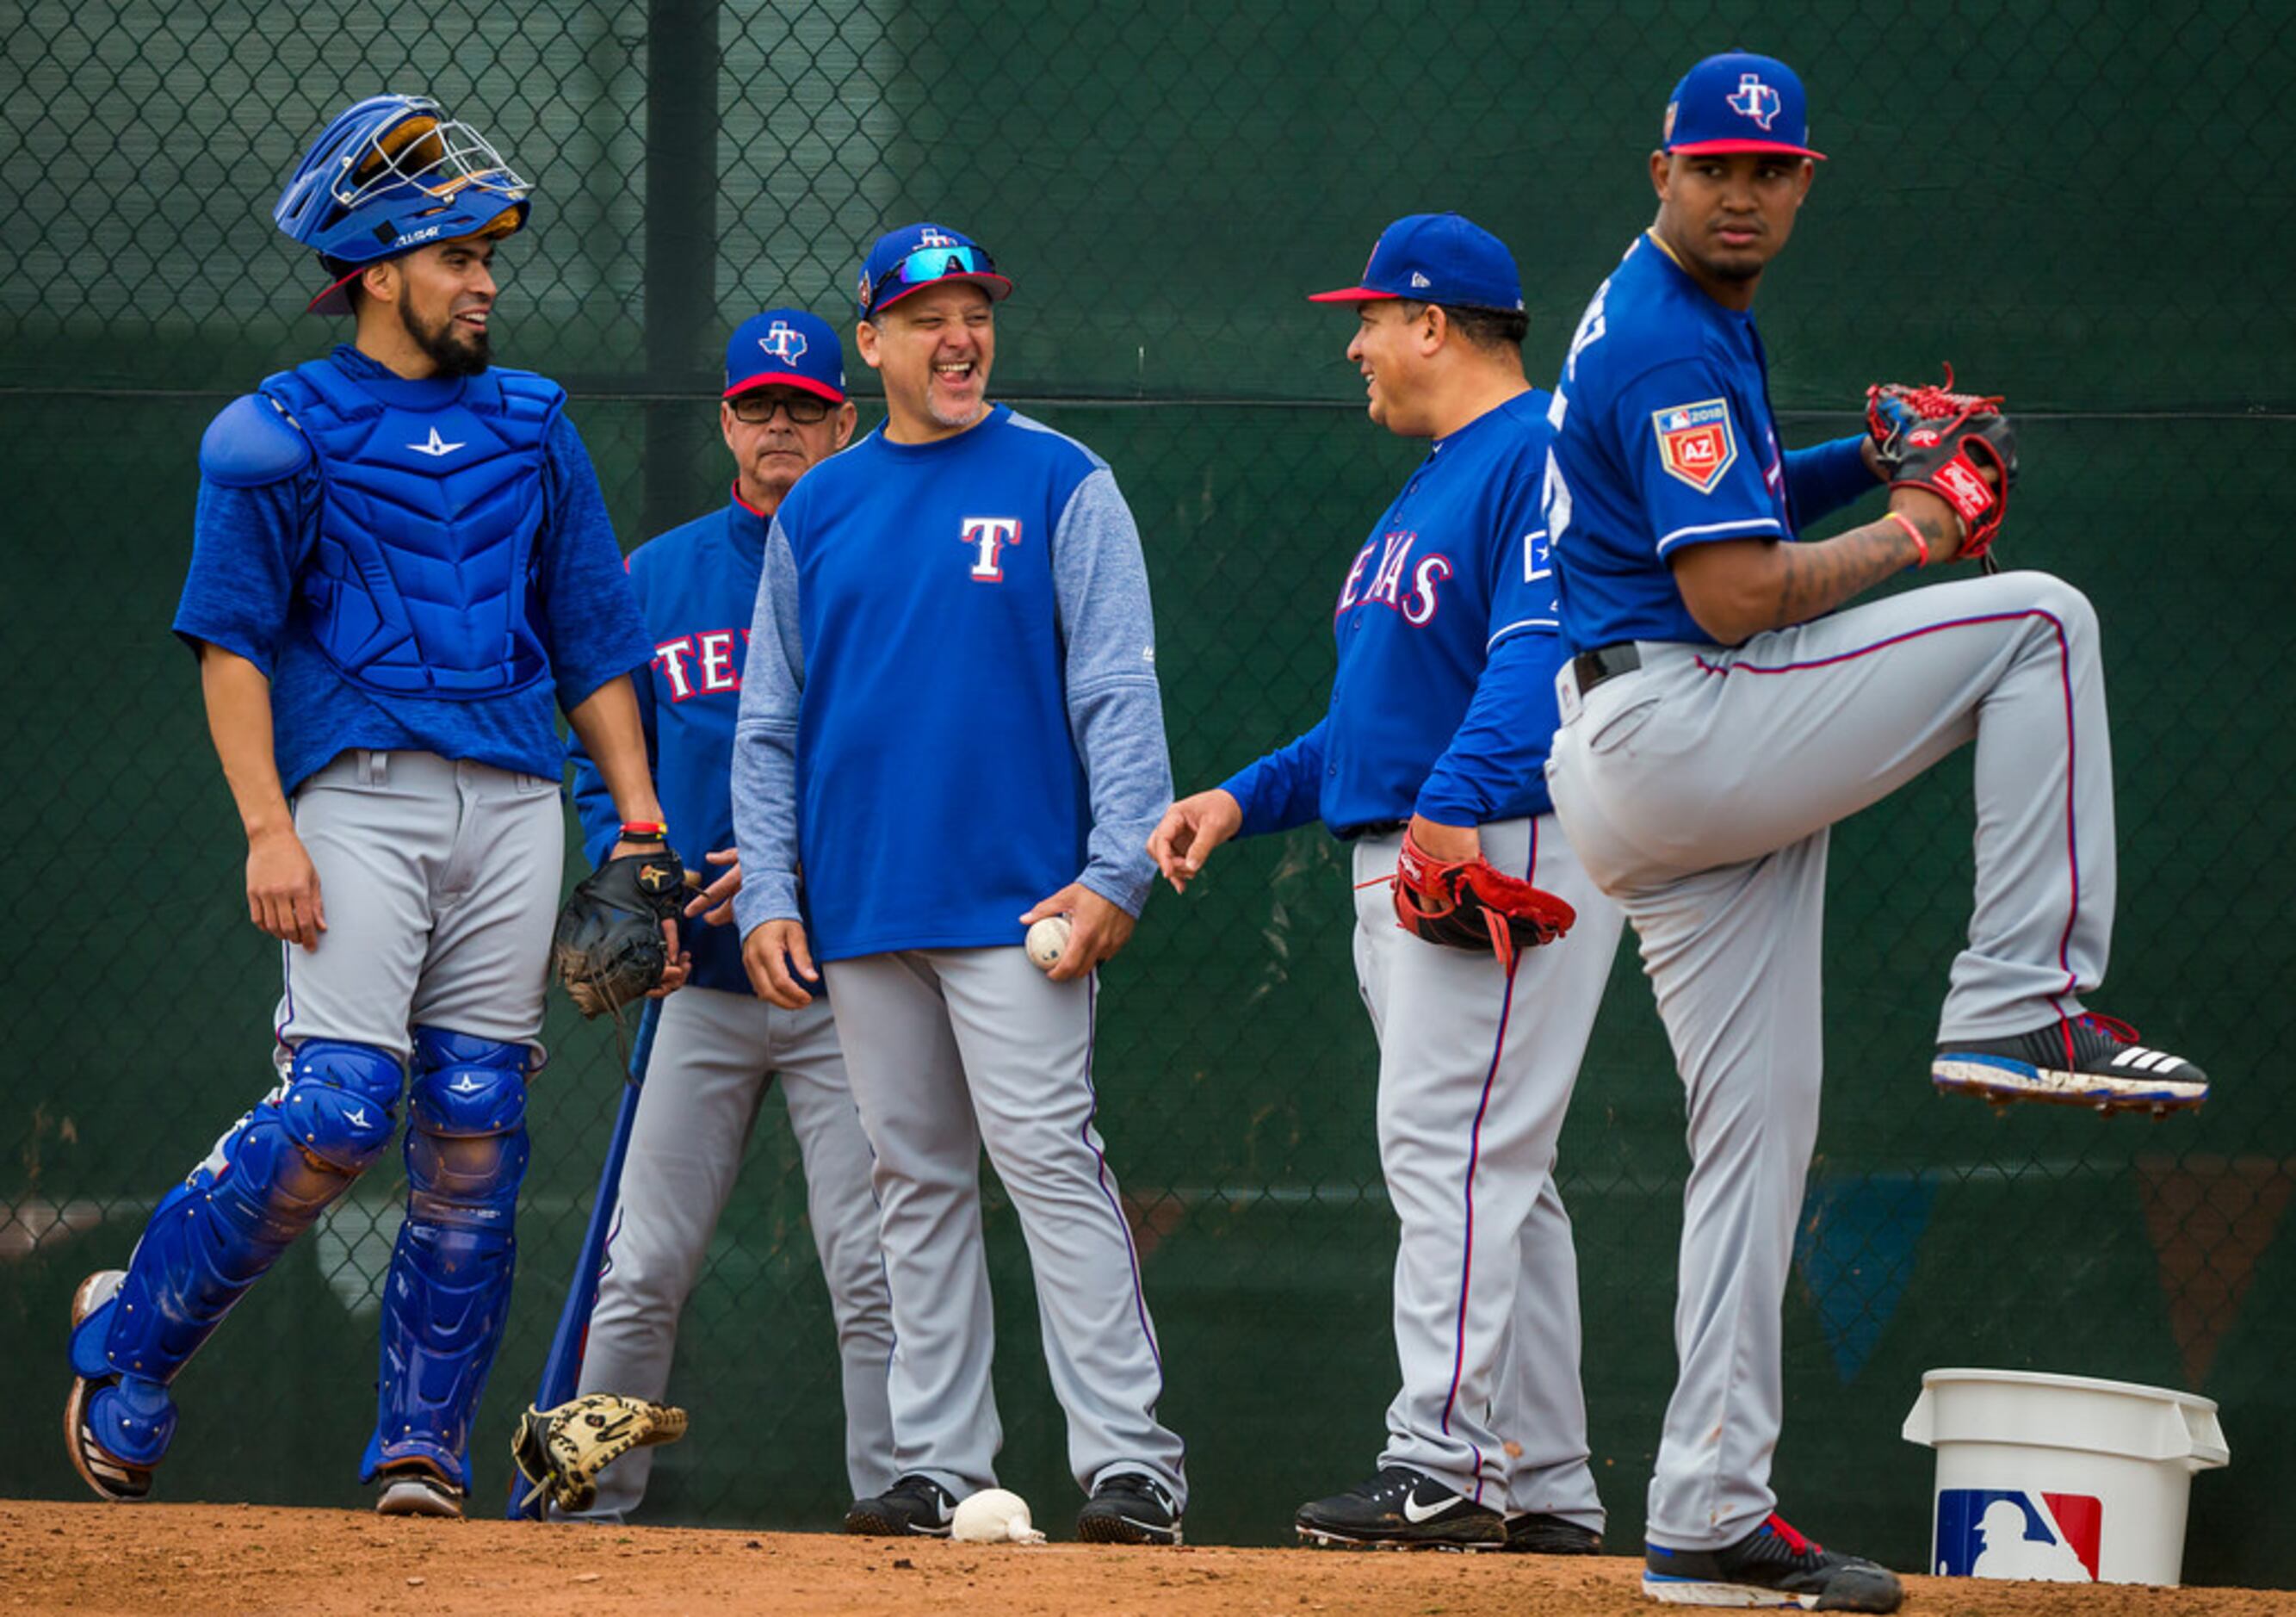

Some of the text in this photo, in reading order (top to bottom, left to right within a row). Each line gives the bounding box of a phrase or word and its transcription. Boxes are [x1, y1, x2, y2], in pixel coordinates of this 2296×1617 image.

[1685, 438, 1713, 462] AZ
[961, 517, 1023, 583] T
[1334, 530, 1454, 629] EXAS
[649, 627, 752, 704] TE
